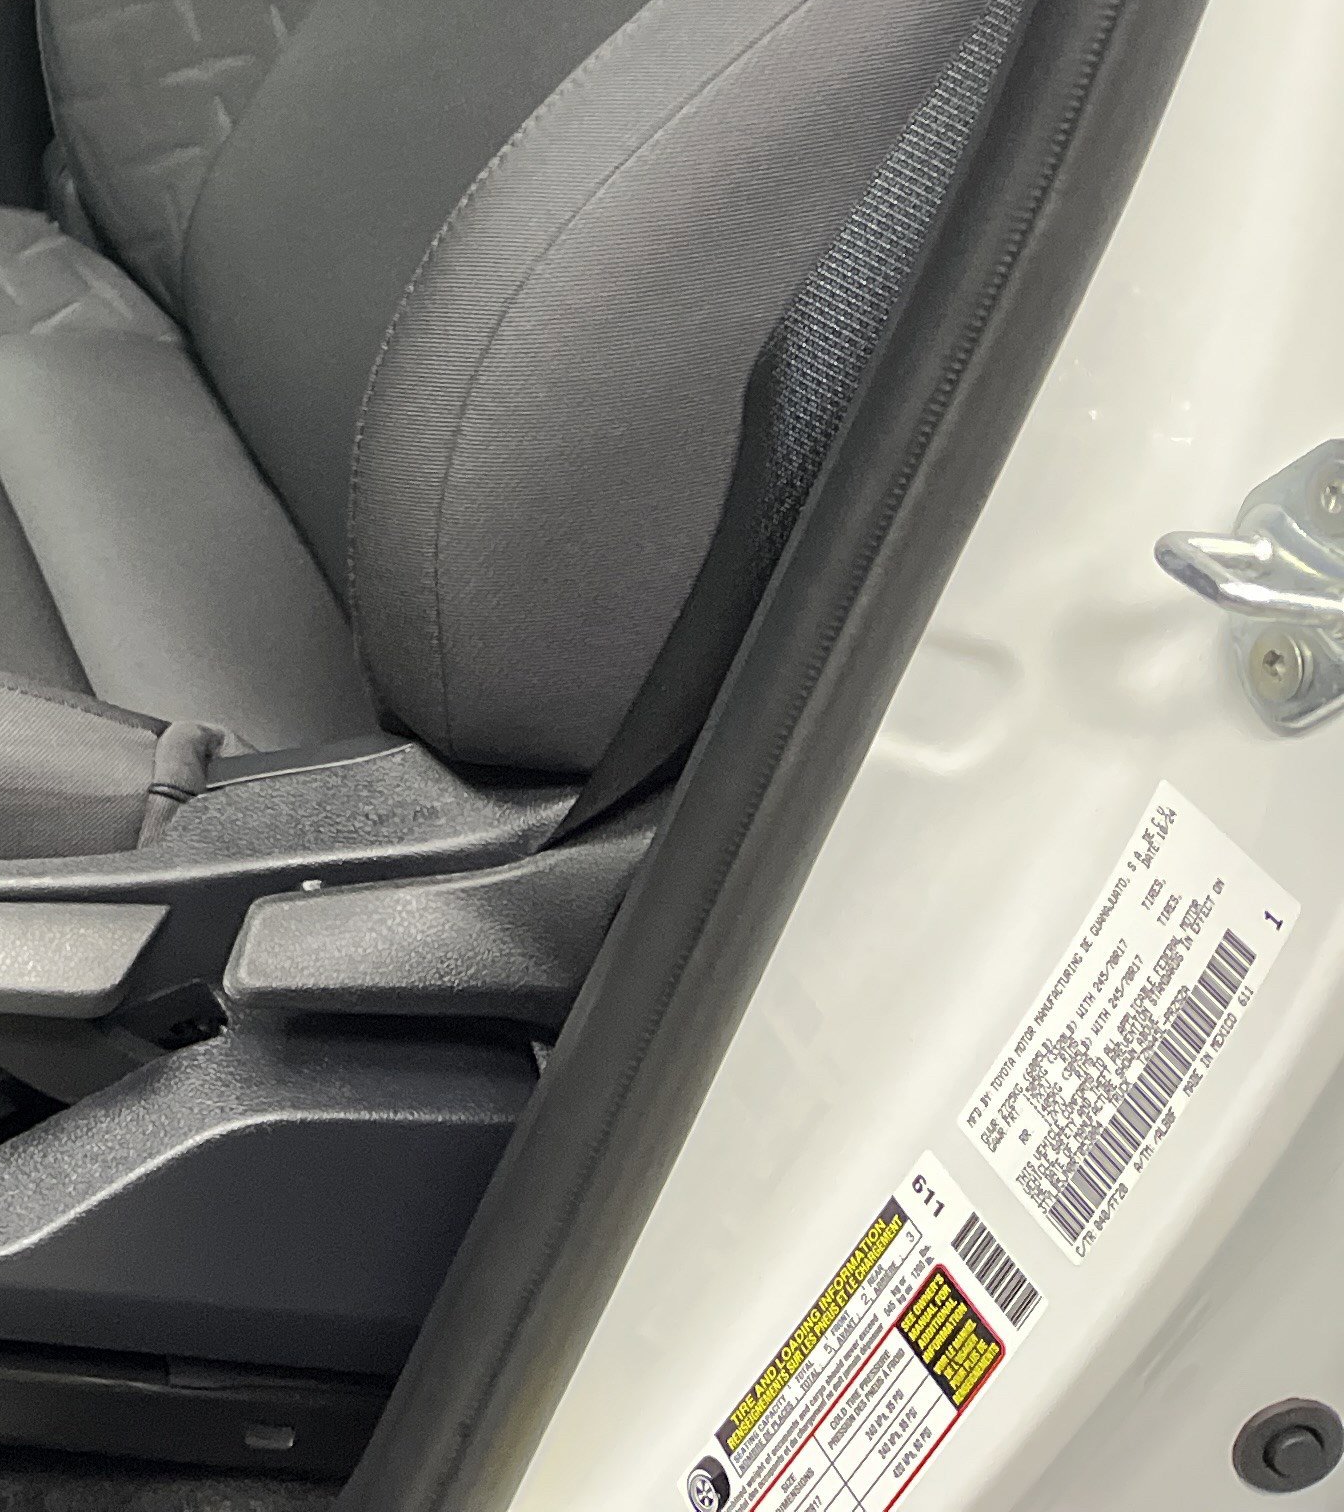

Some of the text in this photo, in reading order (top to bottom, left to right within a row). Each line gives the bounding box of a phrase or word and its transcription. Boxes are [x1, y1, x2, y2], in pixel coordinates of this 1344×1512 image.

[1263, 909, 1284, 931] 1
[989, 1055, 1017, 1092] TOYOTA
[1012, 1024, 1037, 1058] MOTOR
[1032, 951, 1083, 1027] MANUFACTURING
[1074, 990, 1096, 1020] WITH
[1075, 1094, 1092, 1120] AND
[1211, 876, 1225, 896] ON
[1089, 1006, 1112, 1036] WITH
[1014, 1159, 1036, 1186] THIS
[1177, 897, 1203, 933] MOTOR
[1181, 1066, 1204, 1098] MADE
[1198, 1050, 1214, 1069] IN
[1208, 1011, 1238, 1053] MEXICO
[1236, 984, 1255, 1008] 611
[910, 1173, 945, 1218] 611
[859, 1291, 871, 1306] 2
[904, 1229, 915, 1243] 3
[727, 1365, 790, 1449] RENSEIGNEMENTS
[784, 1348, 805, 1375] SUR
[800, 1330, 818, 1355] LES
[812, 1300, 840, 1336] PNEUS
[834, 1288, 849, 1307] ET
[845, 1275, 859, 1293] LE
[852, 1215, 901, 1280] CHARGEMENT
[730, 1394, 757, 1425] TIRE
[754, 1364, 778, 1400] AND
[775, 1308, 822, 1369] LOADING
[818, 1219, 887, 1311] INFORMATION
[900, 1311, 917, 1331] SEE
[912, 1274, 945, 1316] OWNER'S
[907, 1282, 951, 1341] MANUAL FOR
[917, 1298, 957, 1349] ADDITIONAL
[922, 1302, 968, 1363] INFORMATION
[732, 1428, 760, 1464] SEATING
[756, 1392, 787, 1433] CAPACITY
[793, 1358, 815, 1384] TOTAL
[829, 1308, 851, 1337] FRONT
[865, 1262, 885, 1288] REAR
[828, 1405, 848, 1431] COLD
[779, 1470, 797, 1494] SIZE
